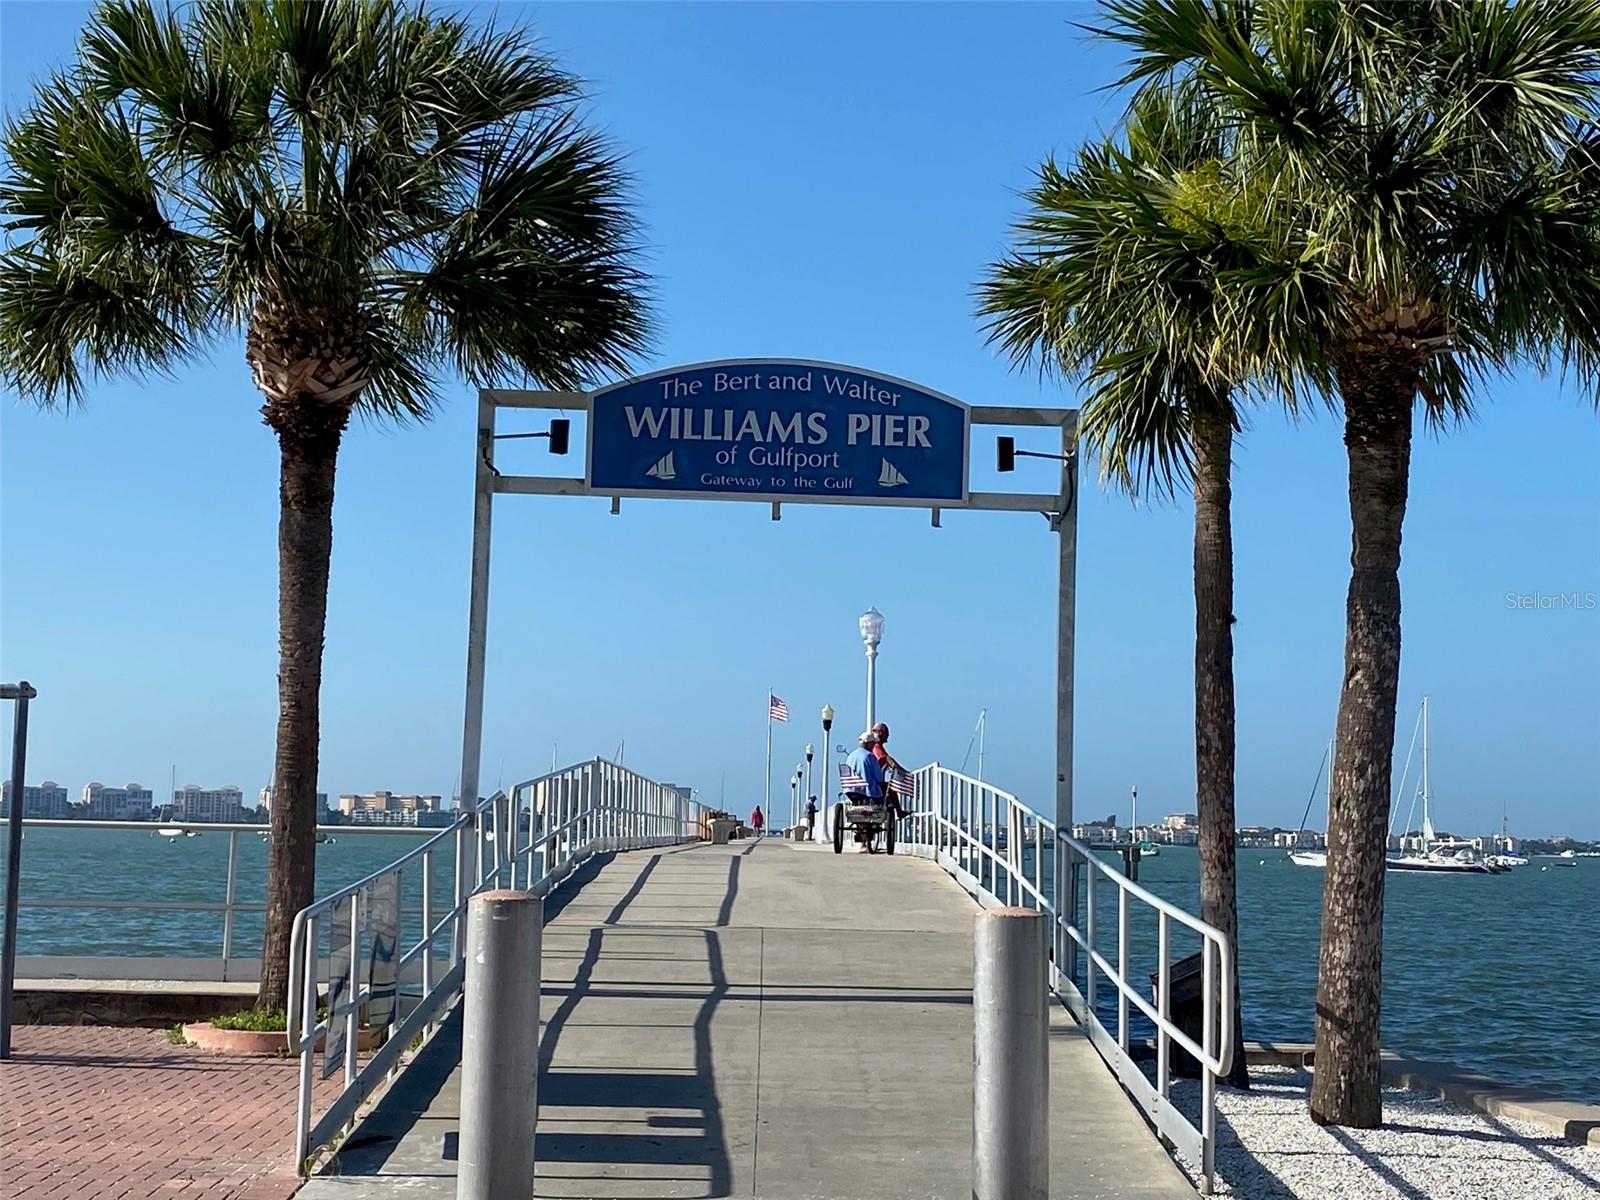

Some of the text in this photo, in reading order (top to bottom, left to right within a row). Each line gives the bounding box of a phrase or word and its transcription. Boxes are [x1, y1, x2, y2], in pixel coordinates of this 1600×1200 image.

[659, 372, 901, 407] The Bert and Walter
[624, 405, 932, 448] WILLIAMS PIER
[715, 445, 840, 472] of Gulfport
[700, 472, 854, 490] Gateway to the Gulf
